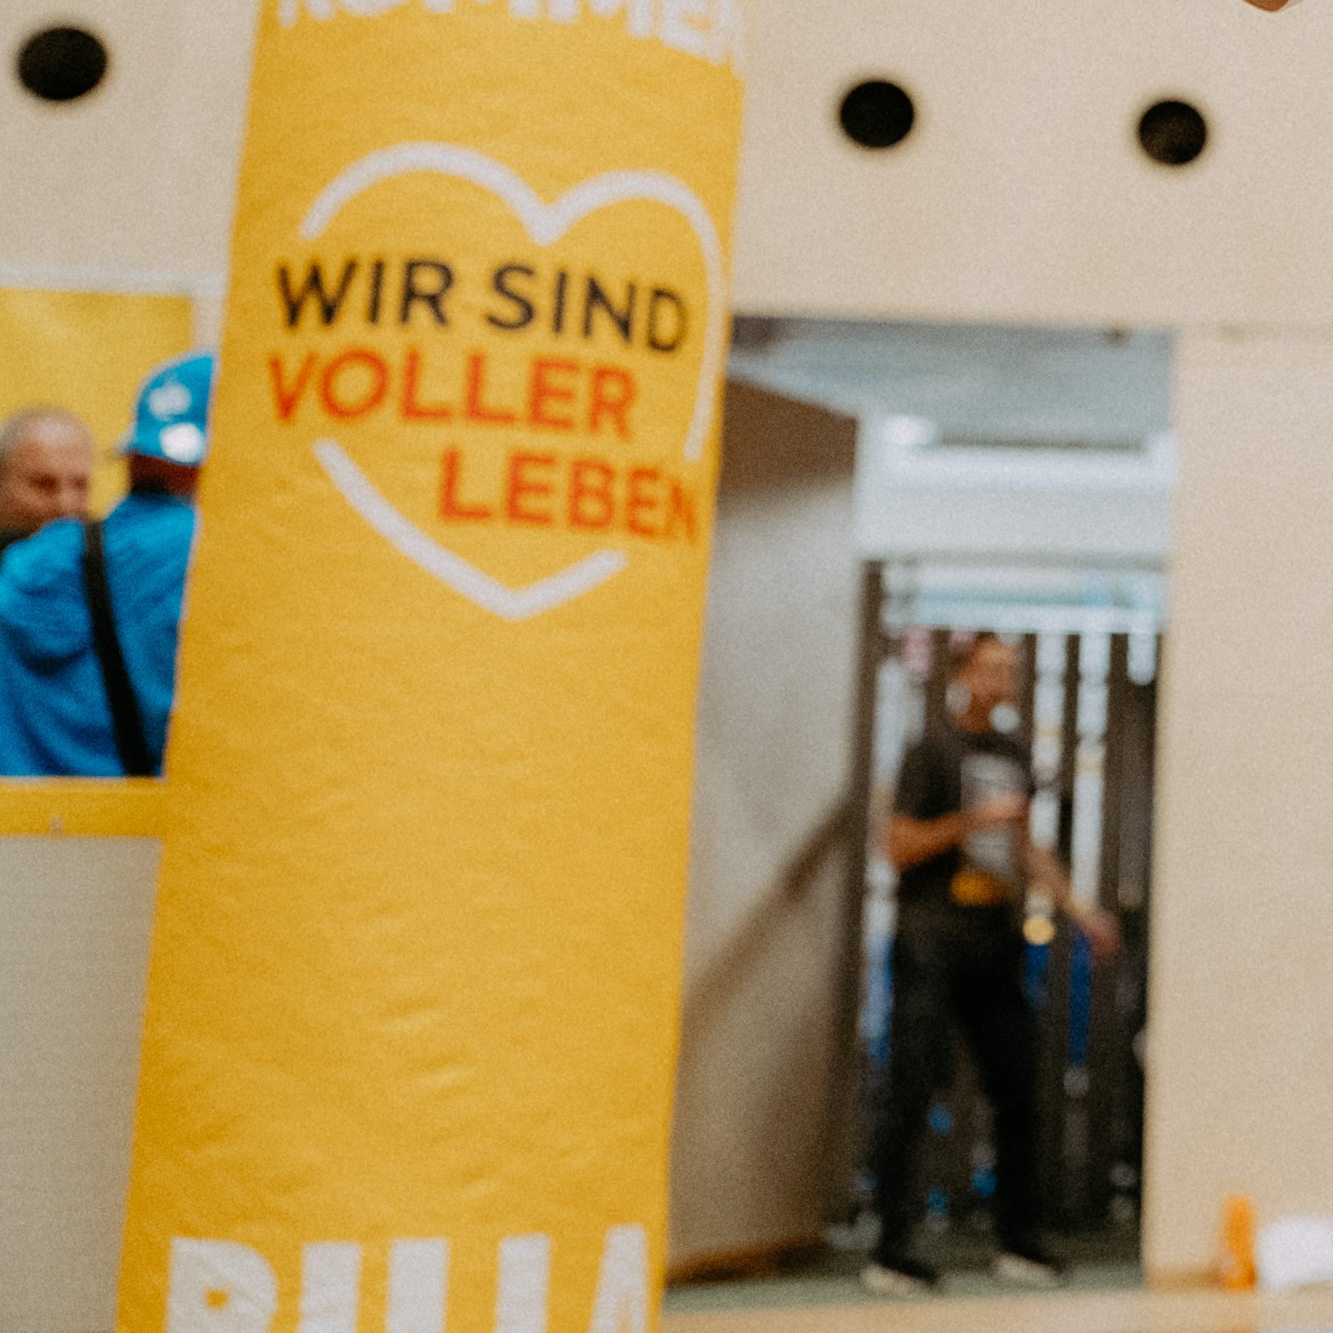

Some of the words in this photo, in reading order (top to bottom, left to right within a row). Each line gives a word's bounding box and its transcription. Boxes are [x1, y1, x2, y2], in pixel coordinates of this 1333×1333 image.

[277, 260, 454, 328] WIR
[485, 265, 687, 353] SIND
[269, 350, 637, 441] VOLLER
[438, 446, 697, 543] LEBEN
